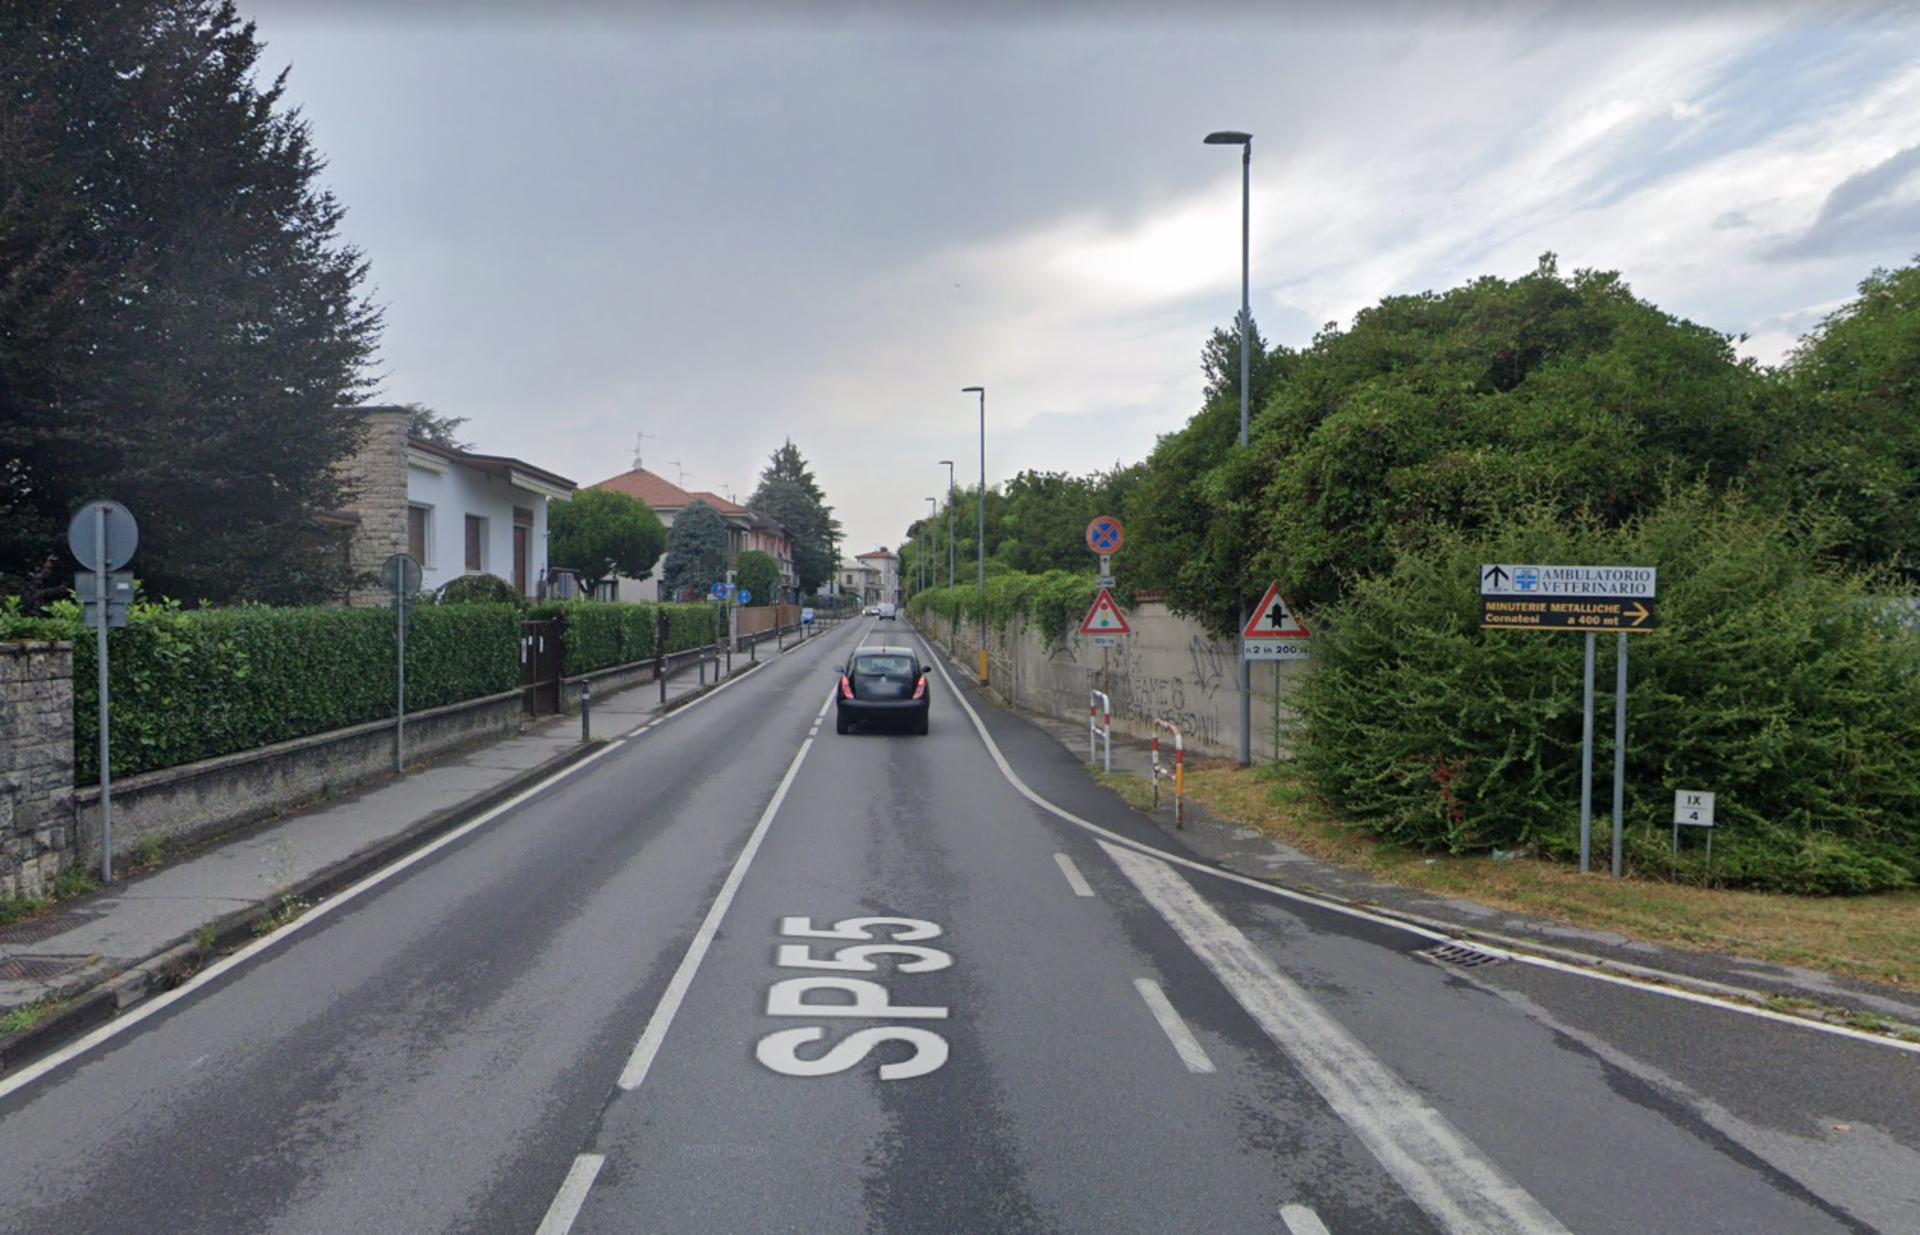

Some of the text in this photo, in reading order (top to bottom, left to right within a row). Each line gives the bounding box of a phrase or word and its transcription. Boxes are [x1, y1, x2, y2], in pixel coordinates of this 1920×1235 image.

[1542, 569, 1650, 582] AMBULATORIO
[1543, 582, 1647, 594] VETERINARIO
[1486, 602, 1621, 614] MINUTERIE METALLICHE
[1567, 617, 1575, 625] a
[1578, 616, 1600, 625] 400
[1603, 616, 1619, 626] mt
[1263, 646, 1273, 654] in
[1276, 645, 1297, 654] 200
[1687, 795, 1701, 805] IX
[1689, 811, 1699, 821] 4
[756, 916, 954, 1080] SP55
